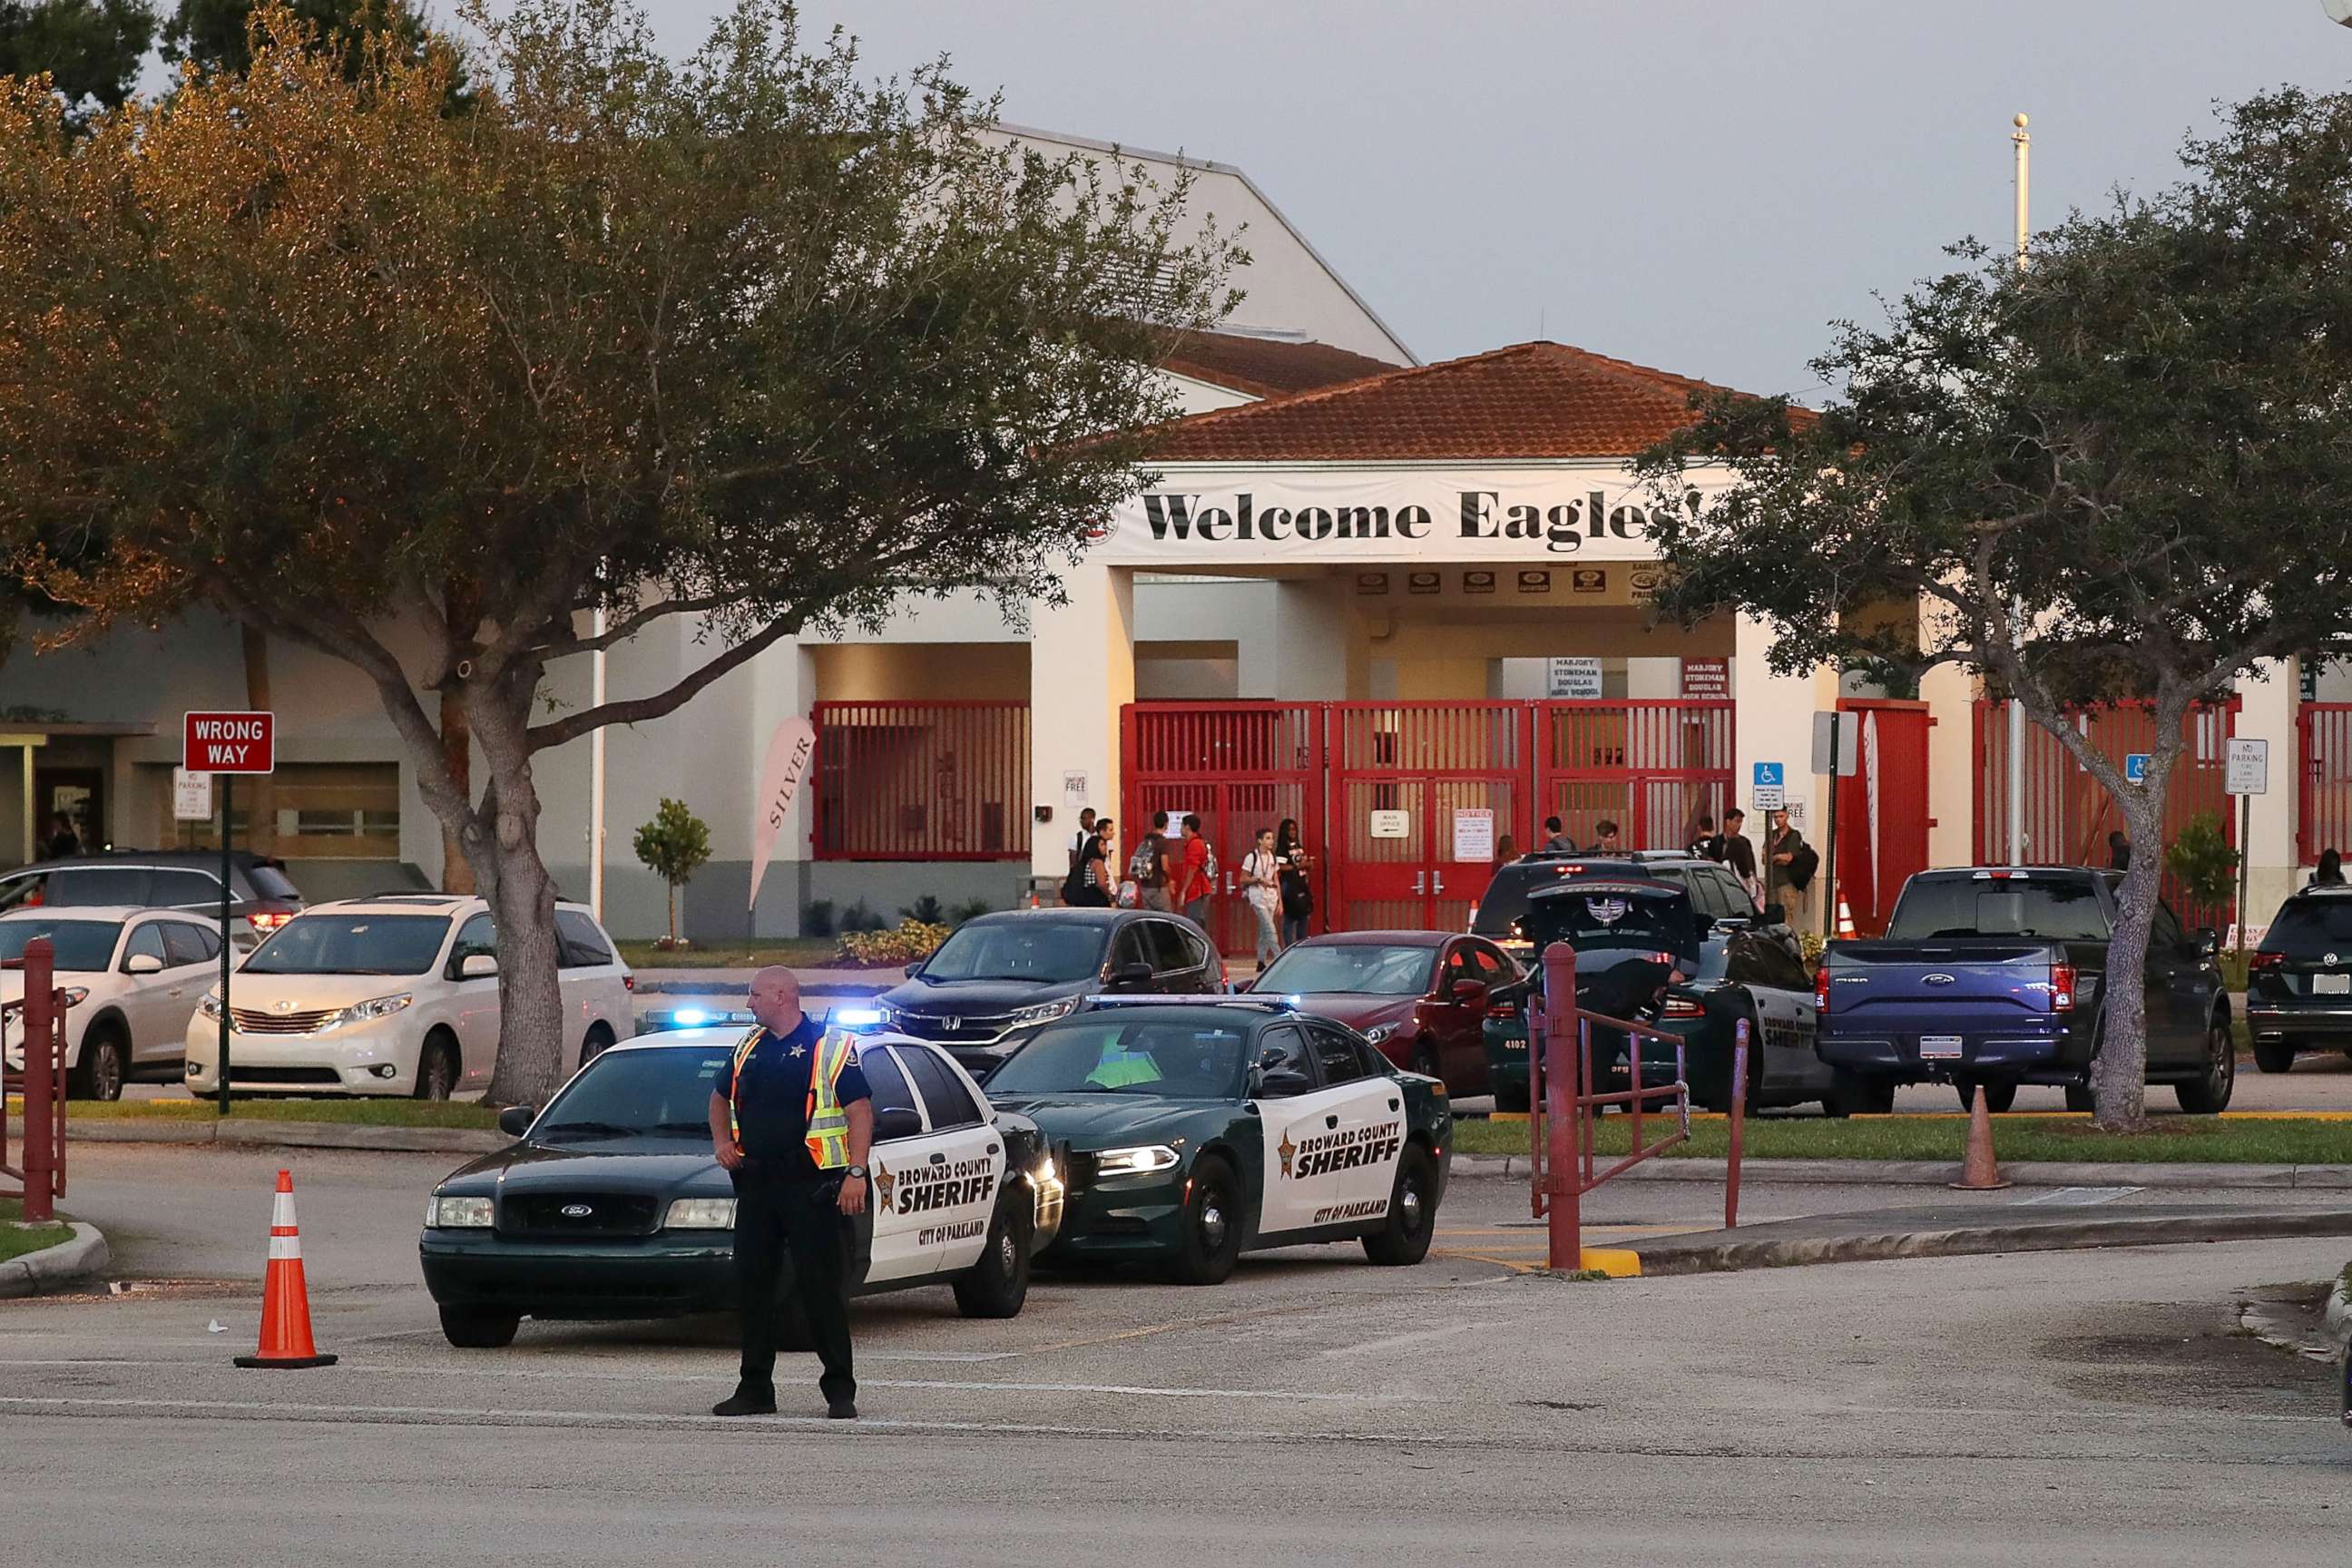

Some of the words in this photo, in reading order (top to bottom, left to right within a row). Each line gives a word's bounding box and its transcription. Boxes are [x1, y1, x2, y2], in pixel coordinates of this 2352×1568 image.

[1142, 493, 1432, 541] Welcome
[196, 720, 263, 740] WRONG
[208, 745, 249, 764] WAY
[2231, 754, 2263, 763] PARKING
[2242, 745, 2252, 753] NO
[769, 737, 810, 829] SILVER
[1065, 782, 1085, 791] FREE
[1788, 808, 1804, 818] REE
[1504, 1040, 1526, 1049] 4102
[1299, 1131, 1356, 1154] BROWARD
[1358, 1122, 1399, 1142] COUNTY
[1295, 1137, 1399, 1180] SHERIFF
[898, 1164, 952, 1187] BROWARD
[955, 1158, 991, 1178] COUNTY
[897, 1174, 995, 1215] SHERIFF
[1313, 1207, 1333, 1223] CITY
[1332, 1205, 1344, 1220] OF
[1343, 1200, 1387, 1219] PARKLAND
[919, 1227, 935, 1246] CITY
[936, 1226, 946, 1243] OF
[946, 1220, 985, 1241] PARKLAND
